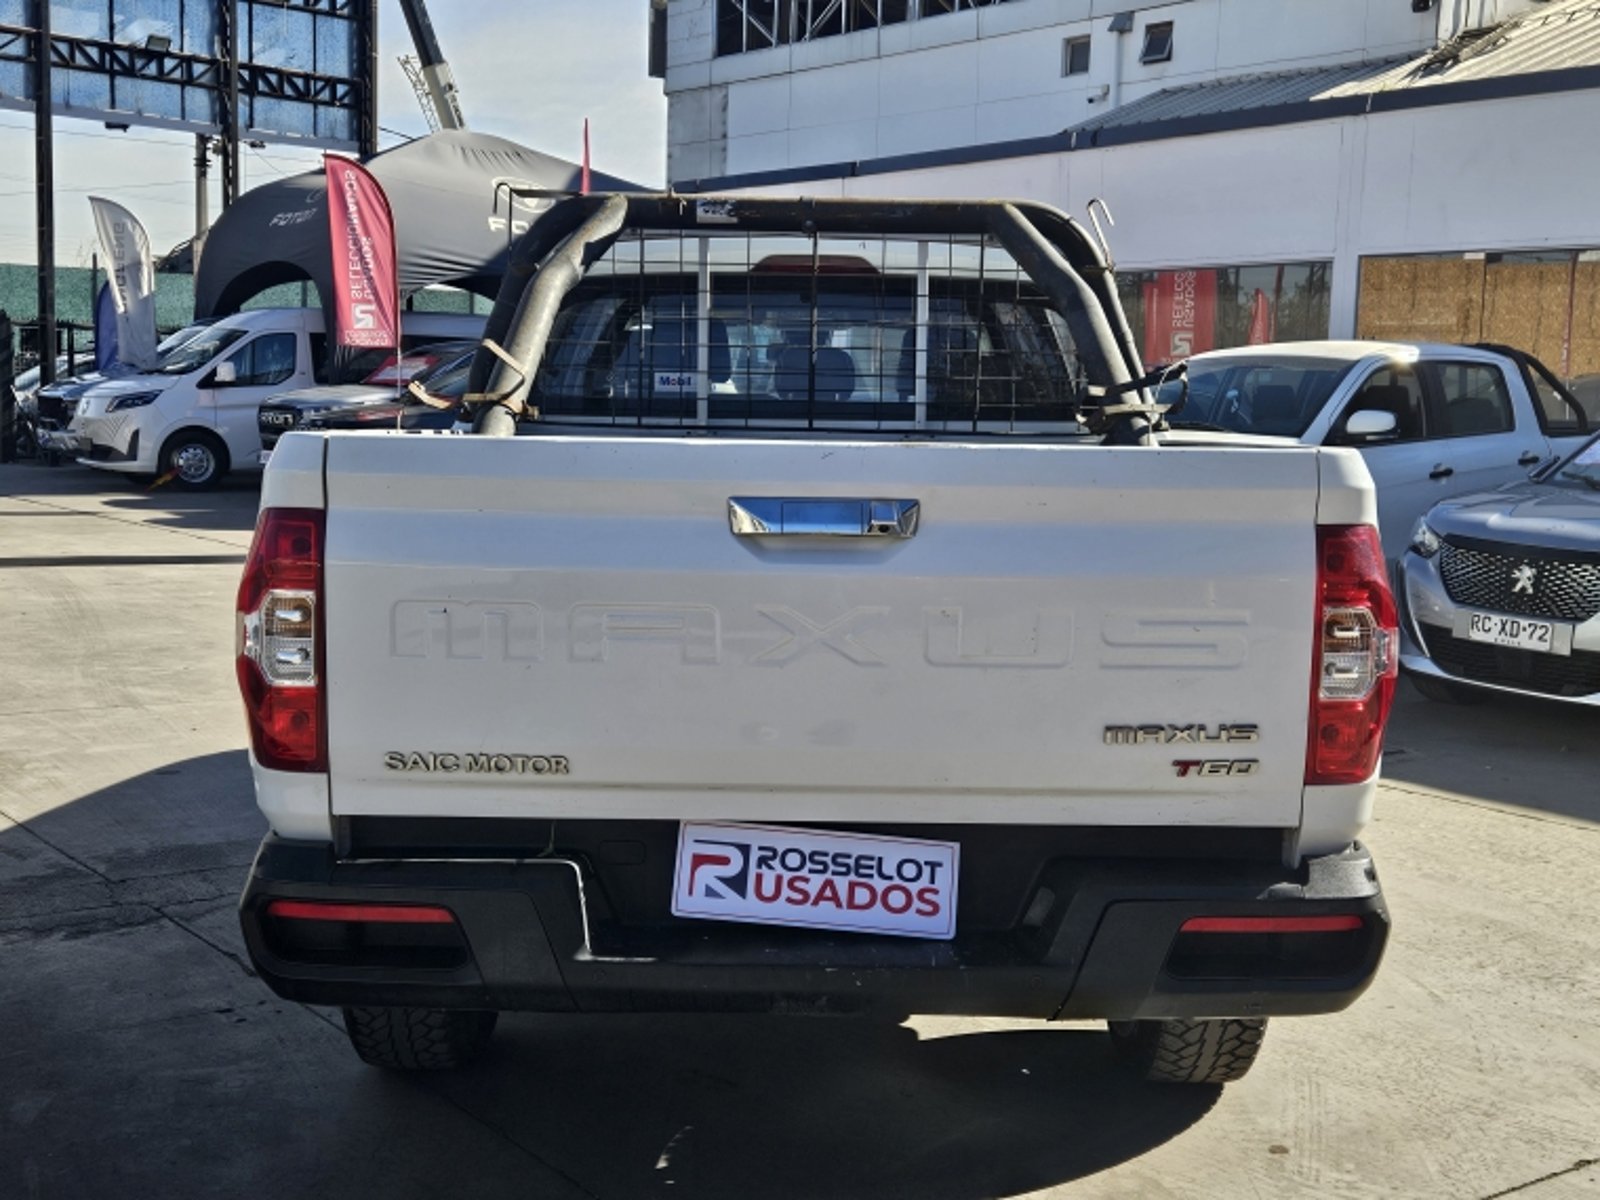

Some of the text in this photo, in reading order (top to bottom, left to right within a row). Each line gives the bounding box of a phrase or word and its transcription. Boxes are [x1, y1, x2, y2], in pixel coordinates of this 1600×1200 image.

[391, 600, 1252, 668] MAXUS
[1103, 723, 1260, 745] MAXUS
[384, 751, 570, 774] SAIC MOTOR
[1171, 759, 1259, 777] T60
[756, 845, 944, 885] ROSSELOT
[753, 872, 941, 918] USADOS
